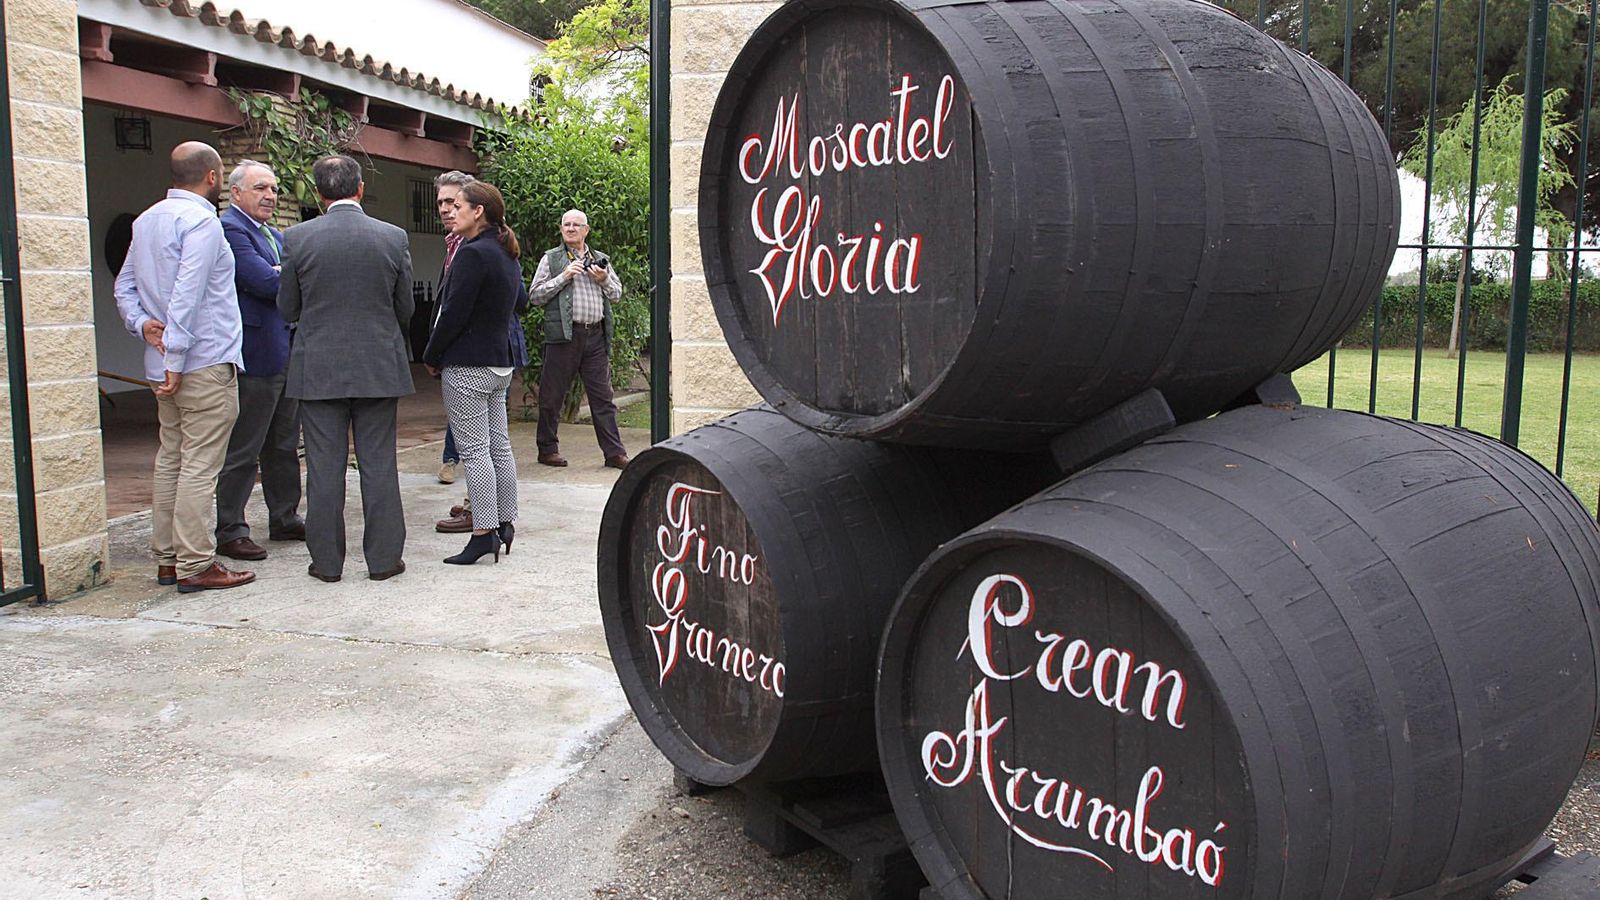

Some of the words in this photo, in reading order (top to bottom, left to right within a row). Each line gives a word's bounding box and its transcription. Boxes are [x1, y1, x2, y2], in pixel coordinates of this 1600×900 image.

[739, 73, 954, 184] Moscatel
[749, 185, 922, 328] Gloria
[657, 481, 758, 585] Fino
[645, 561, 786, 698] Granero
[921, 677, 1228, 886] Arrumbaó
